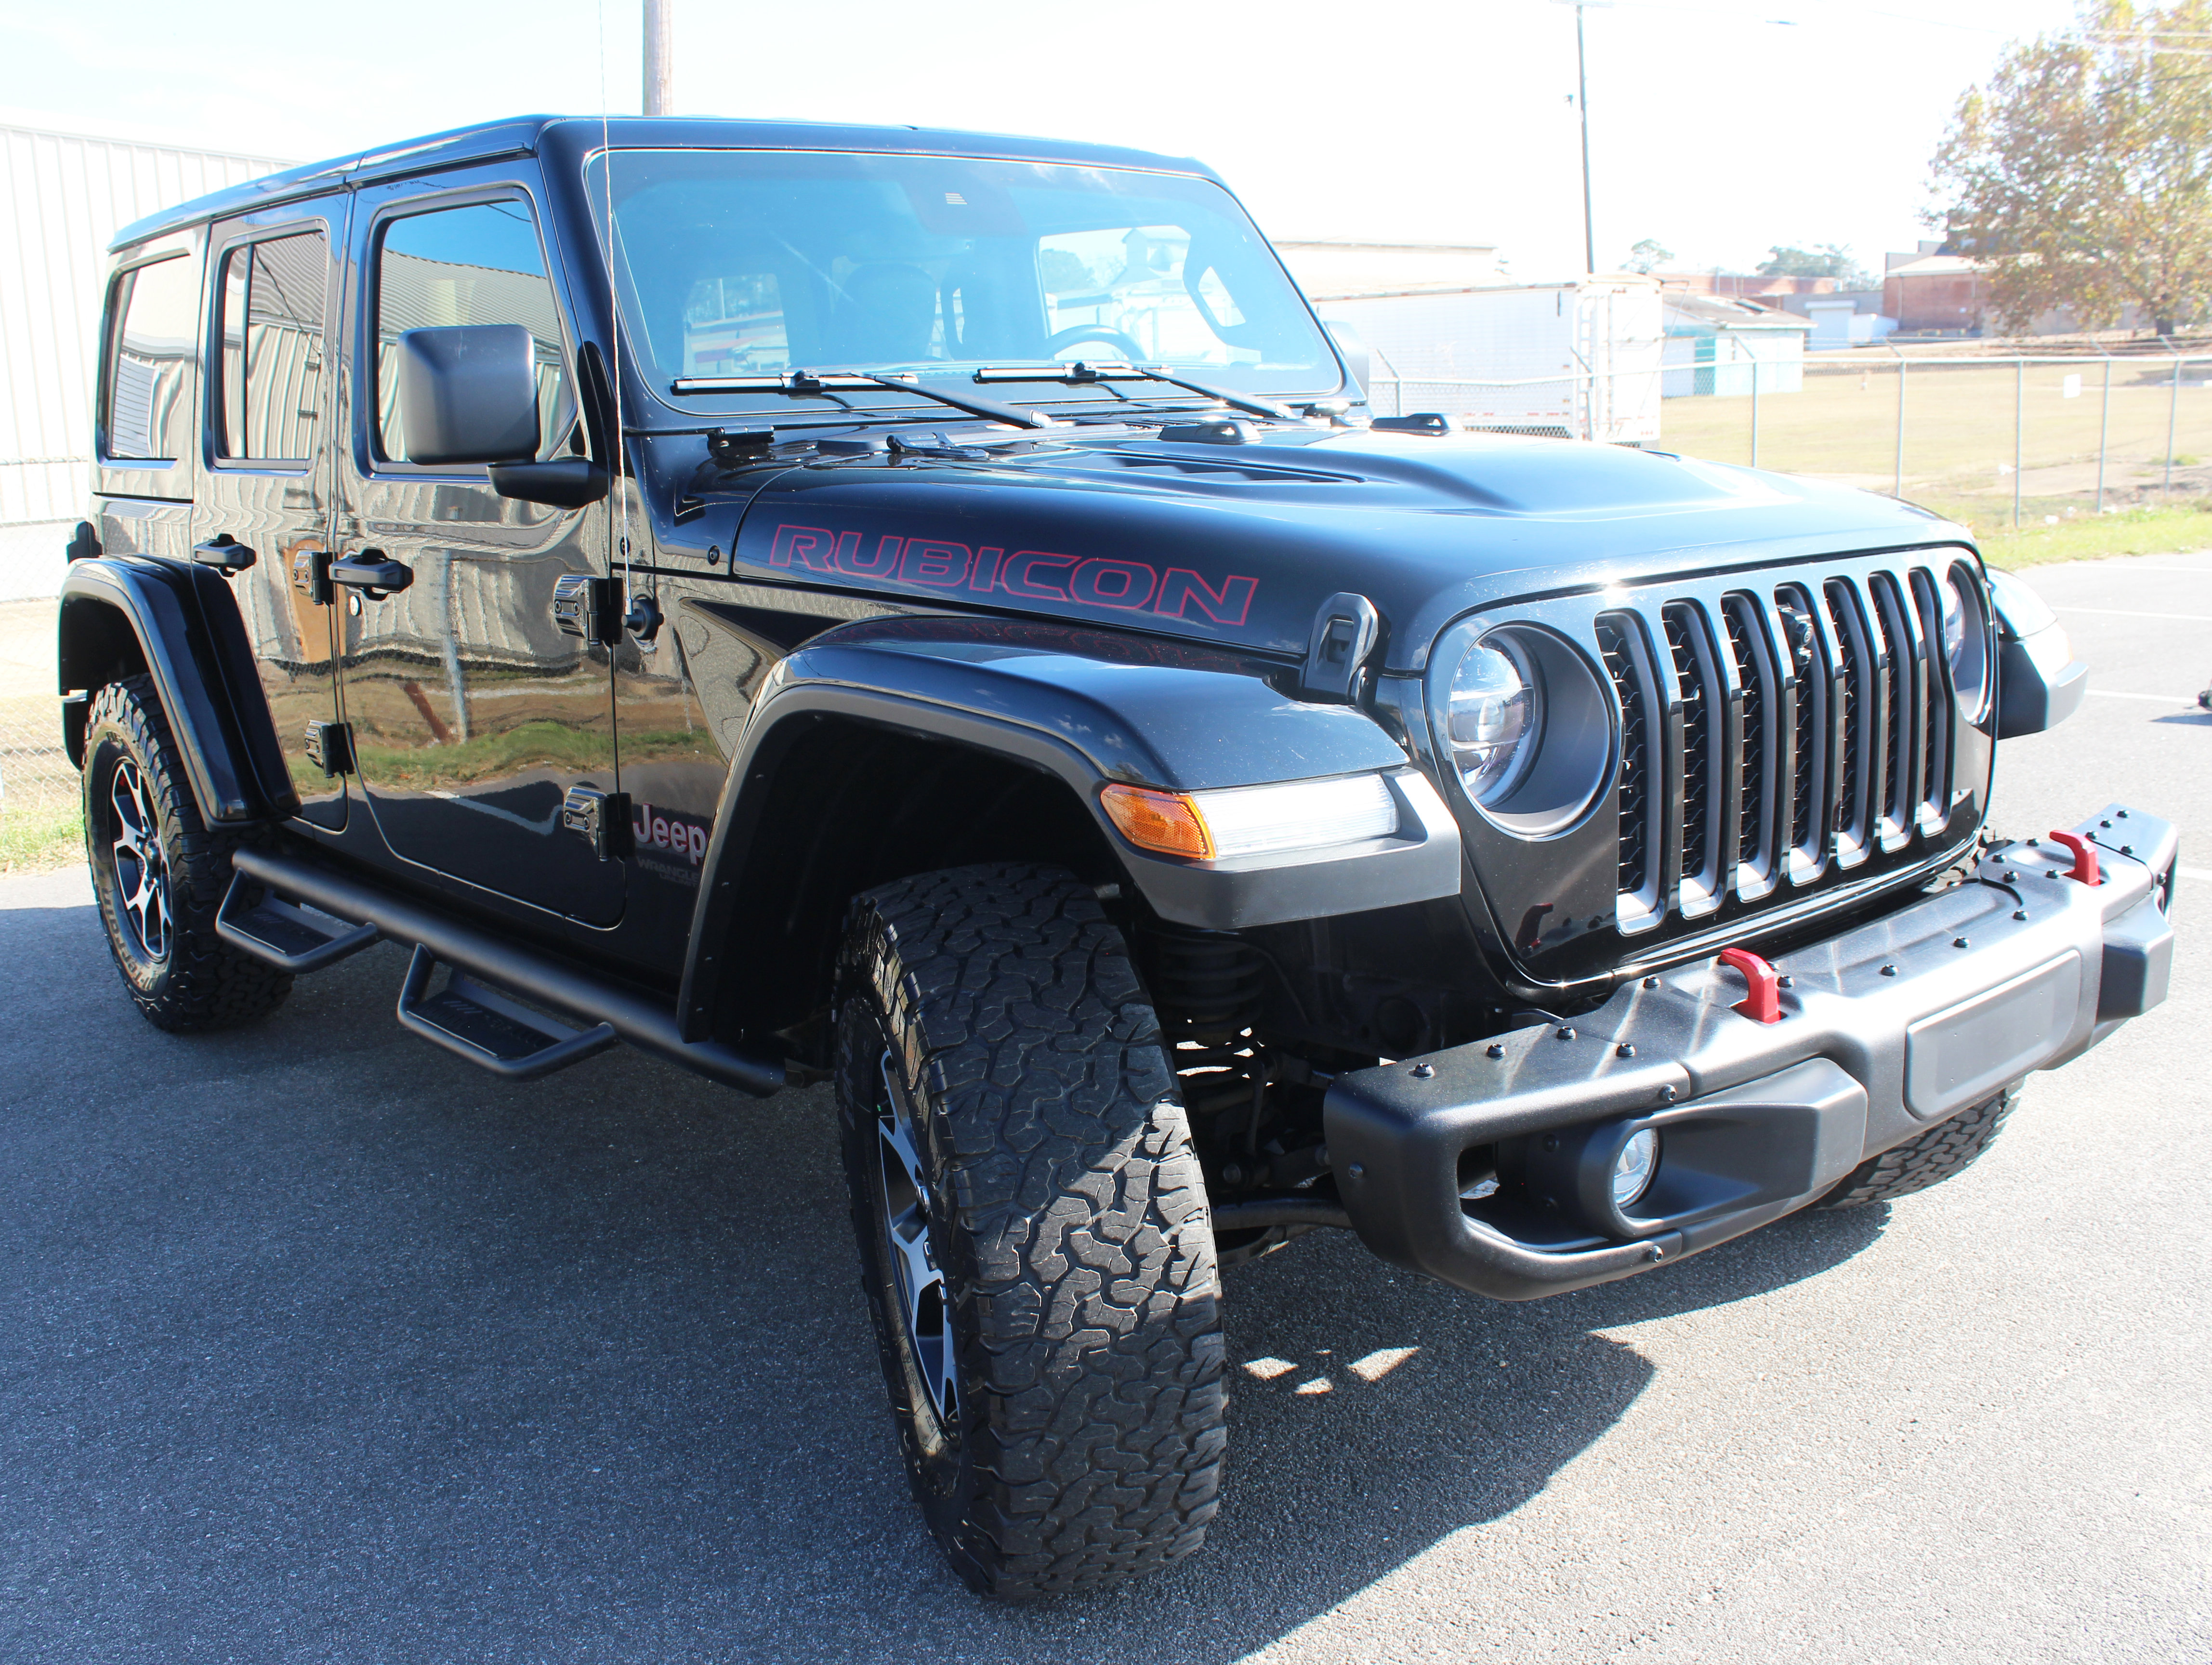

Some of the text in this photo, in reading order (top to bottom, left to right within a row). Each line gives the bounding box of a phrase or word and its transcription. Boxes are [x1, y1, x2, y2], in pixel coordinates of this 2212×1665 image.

[769, 524, 1259, 626] RUBICON
[632, 803, 707, 865] Jeep
[636, 856, 699, 882] WRANGLE
[659, 871, 698, 887] UNLIMIT
